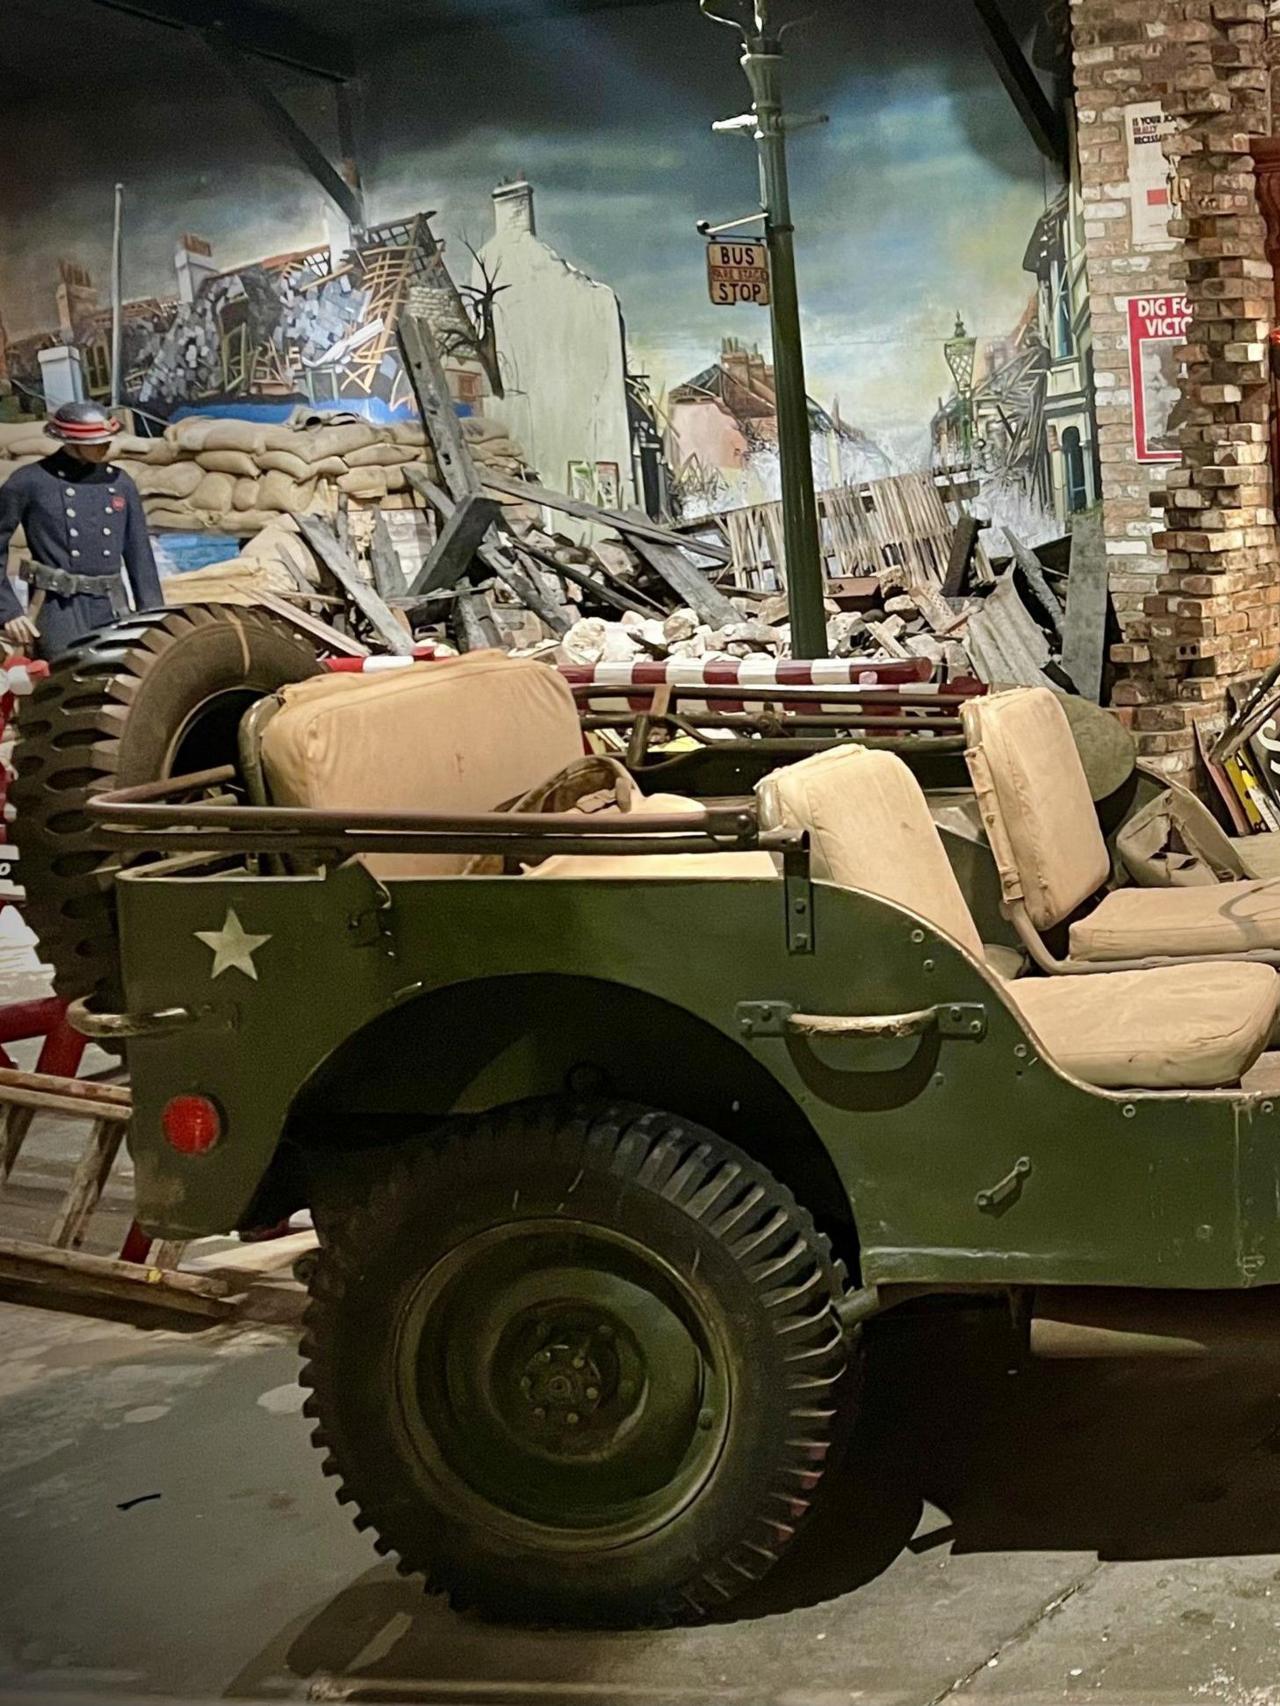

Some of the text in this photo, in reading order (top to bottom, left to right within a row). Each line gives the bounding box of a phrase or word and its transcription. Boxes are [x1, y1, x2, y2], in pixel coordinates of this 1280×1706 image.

[720, 246, 755, 266] BUS
[718, 282, 761, 302] STOP
[1137, 299, 1167, 318] DIG
